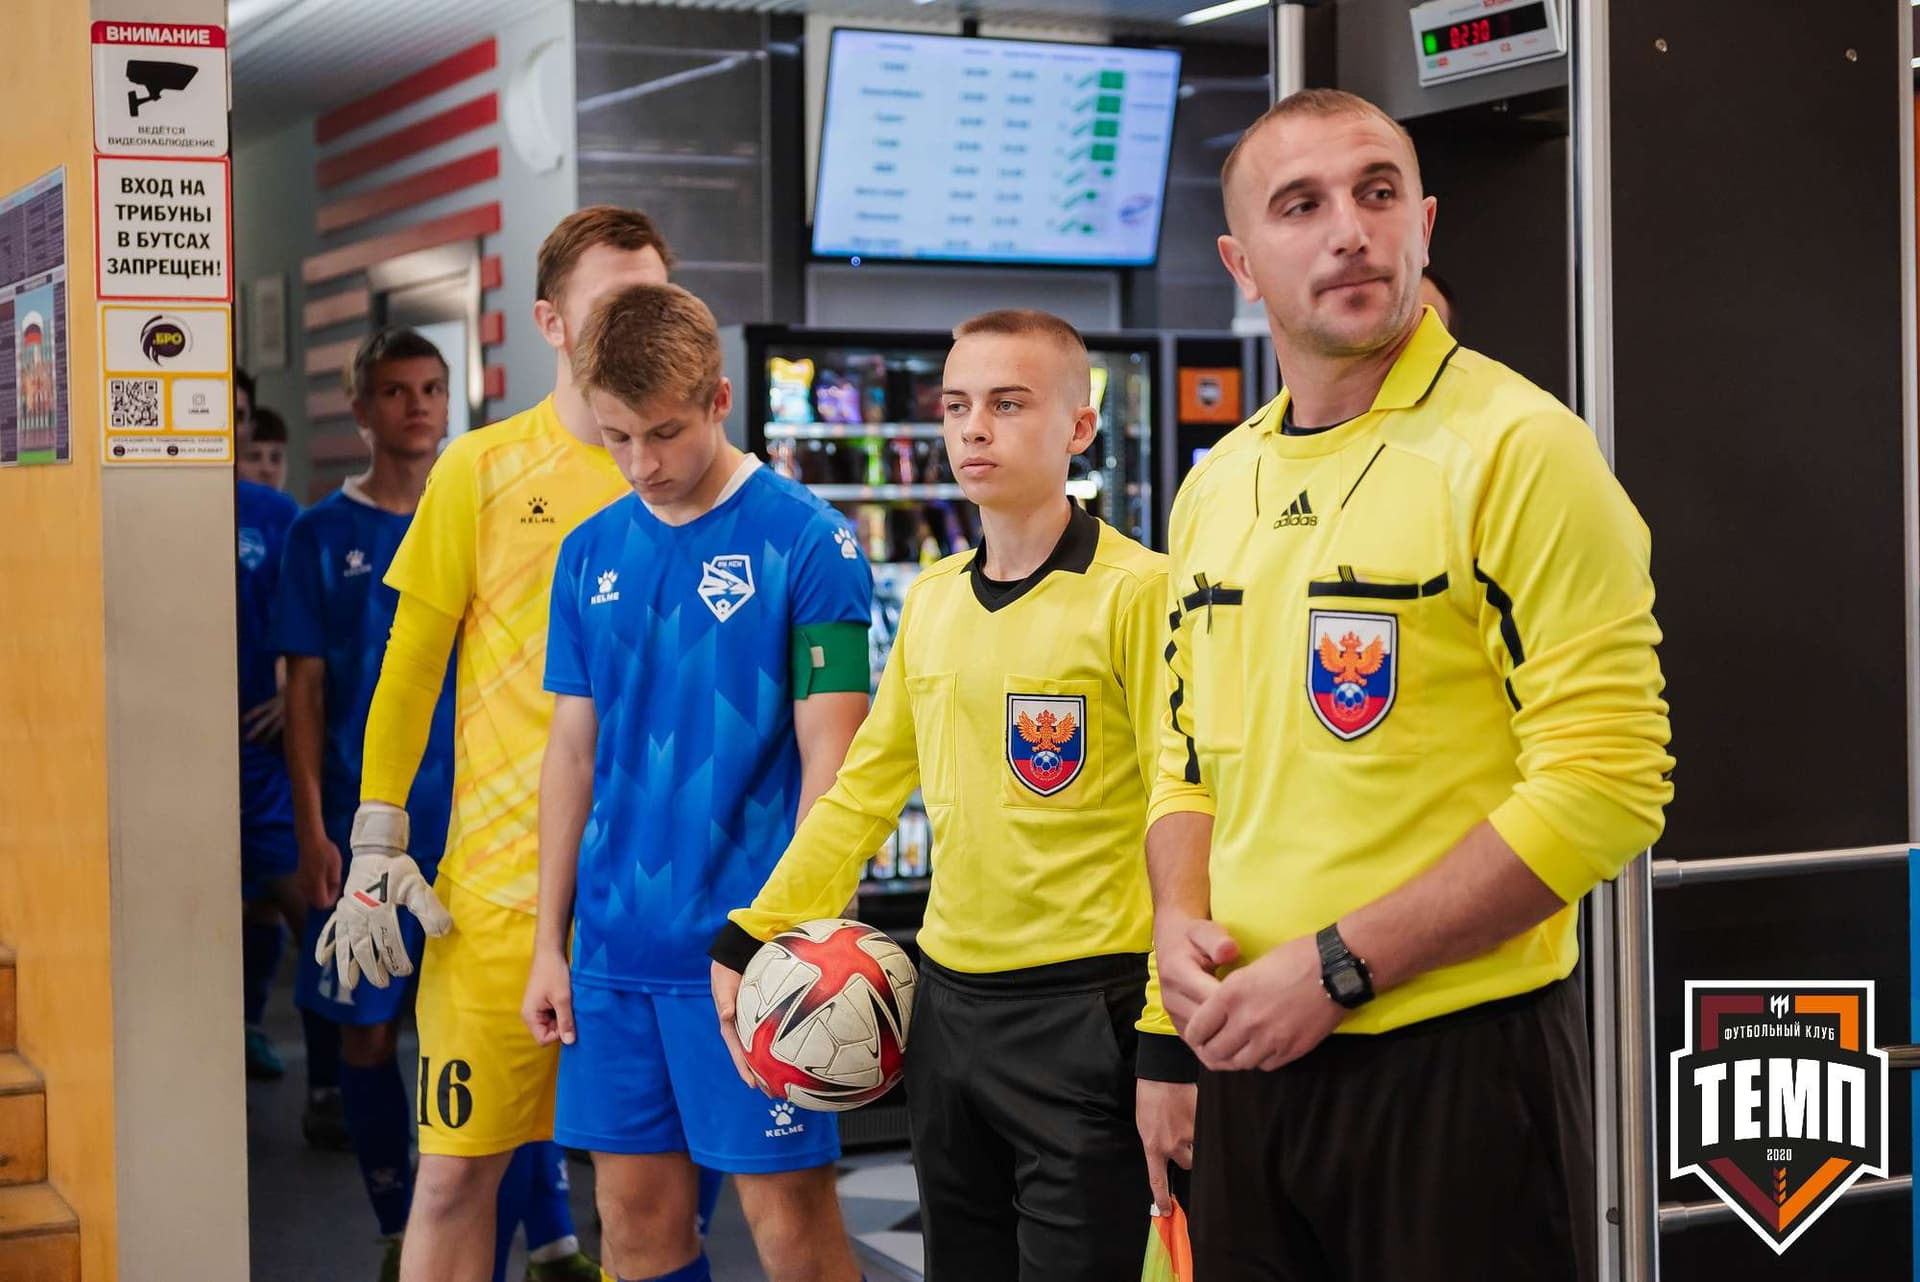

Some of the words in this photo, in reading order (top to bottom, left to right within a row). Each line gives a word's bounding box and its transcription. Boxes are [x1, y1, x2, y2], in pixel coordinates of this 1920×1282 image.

[106, 26, 210, 45] ВНИМАНИЕ
[108, 136, 215, 147] ВИДЕОНАБЛЮДЕНИЕ
[121, 177, 174, 198] ВХОД
[180, 179, 205, 195] НА
[115, 204, 211, 222] ТРИБУНЫ
[118, 231, 130, 247] В
[137, 232, 210, 249] БУТСАХ
[107, 258, 221, 279] ЗАПРЕЩЕН!
[1272, 515, 1318, 529] adidas
[591, 592, 620, 605] KELME
[418, 1056, 473, 1129] 16
[765, 1124, 805, 1137] KELME
